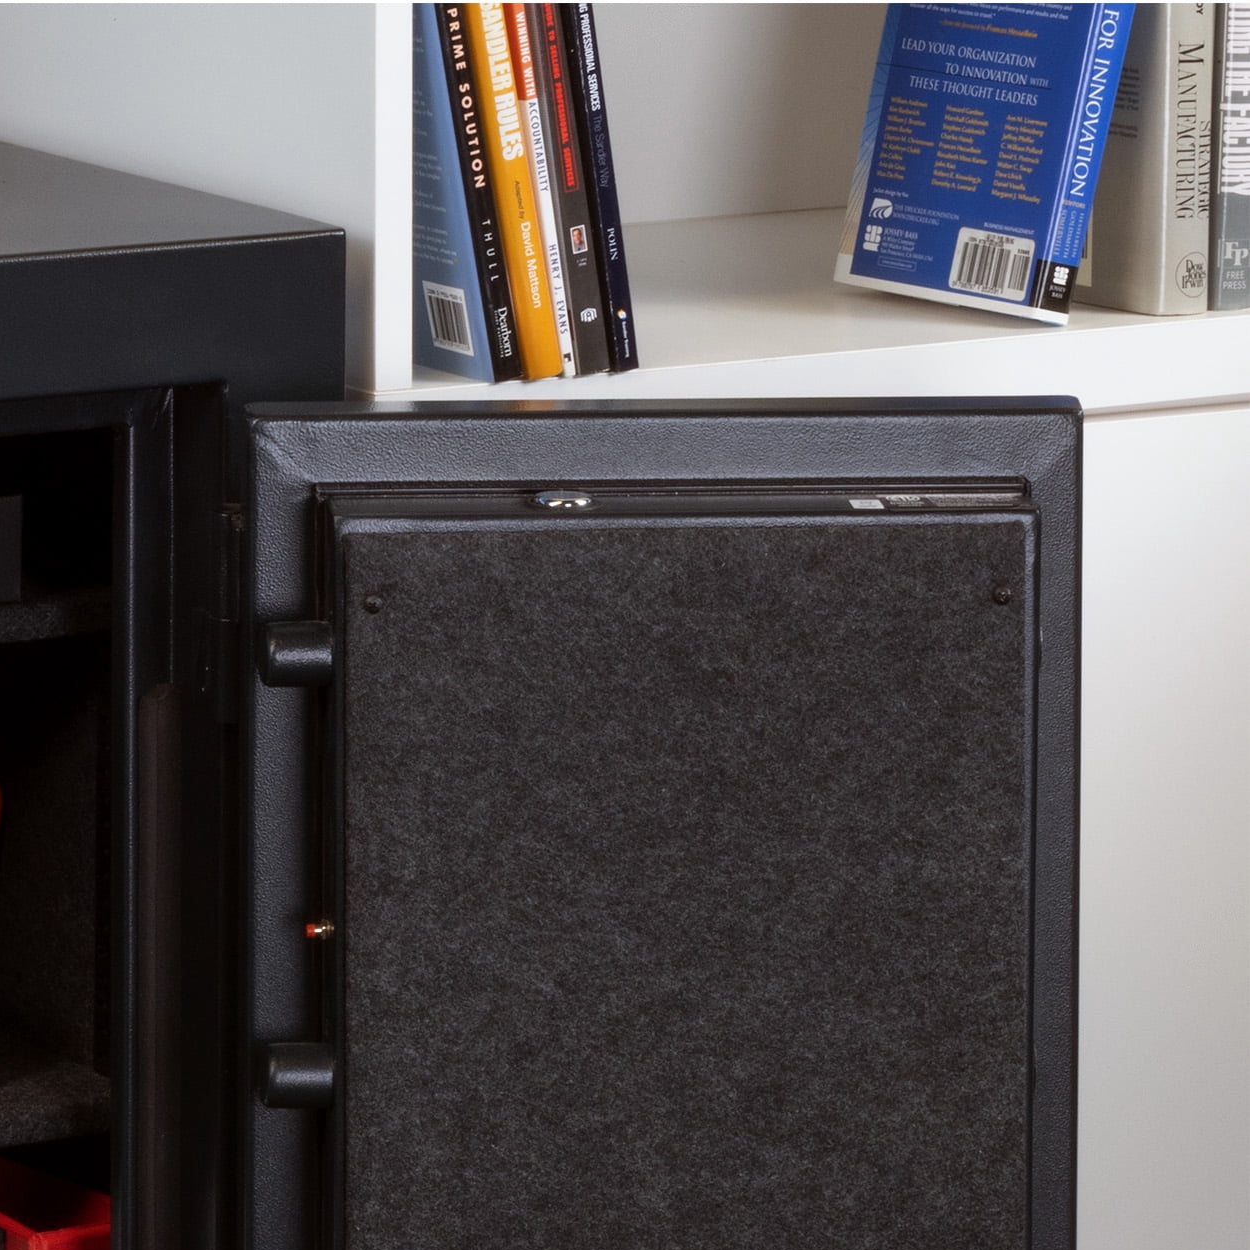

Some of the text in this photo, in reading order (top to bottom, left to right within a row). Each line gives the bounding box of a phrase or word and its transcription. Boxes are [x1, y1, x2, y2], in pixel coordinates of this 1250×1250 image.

[516, 11, 536, 98] WINNING WITH
[579, 13, 596, 74] PROFESSIONAL
[901, 38, 1037, 68] LEAD YOUR ORGANIZATION
[945, 62, 959, 75] TO
[961, 65, 1028, 86] INNOVATION
[447, 8, 486, 189] PRIME SOLUTION
[587, 73, 601, 112] SERVICES
[909, 75, 1038, 107] THESE THOUGHT LEADERS
[1070, 9, 1120, 197] FOR INNOVATION
[494, 92, 524, 161] RULES
[528, 102, 549, 192] ACCOUNTABILITY
[1175, 41, 1205, 219] MANUFACTURING
[1197, 121, 1211, 219] STRATEGIC
[520, 221, 541, 308] David Mattson
[607, 228, 618, 261] POLIN
[1226, 270, 1245, 280] FREE
[549, 244, 561, 280] HENRY
[557, 300, 568, 335] EVANS
[1222, 281, 1247, 290] PRESS
[498, 307, 513, 357] Dearborn
